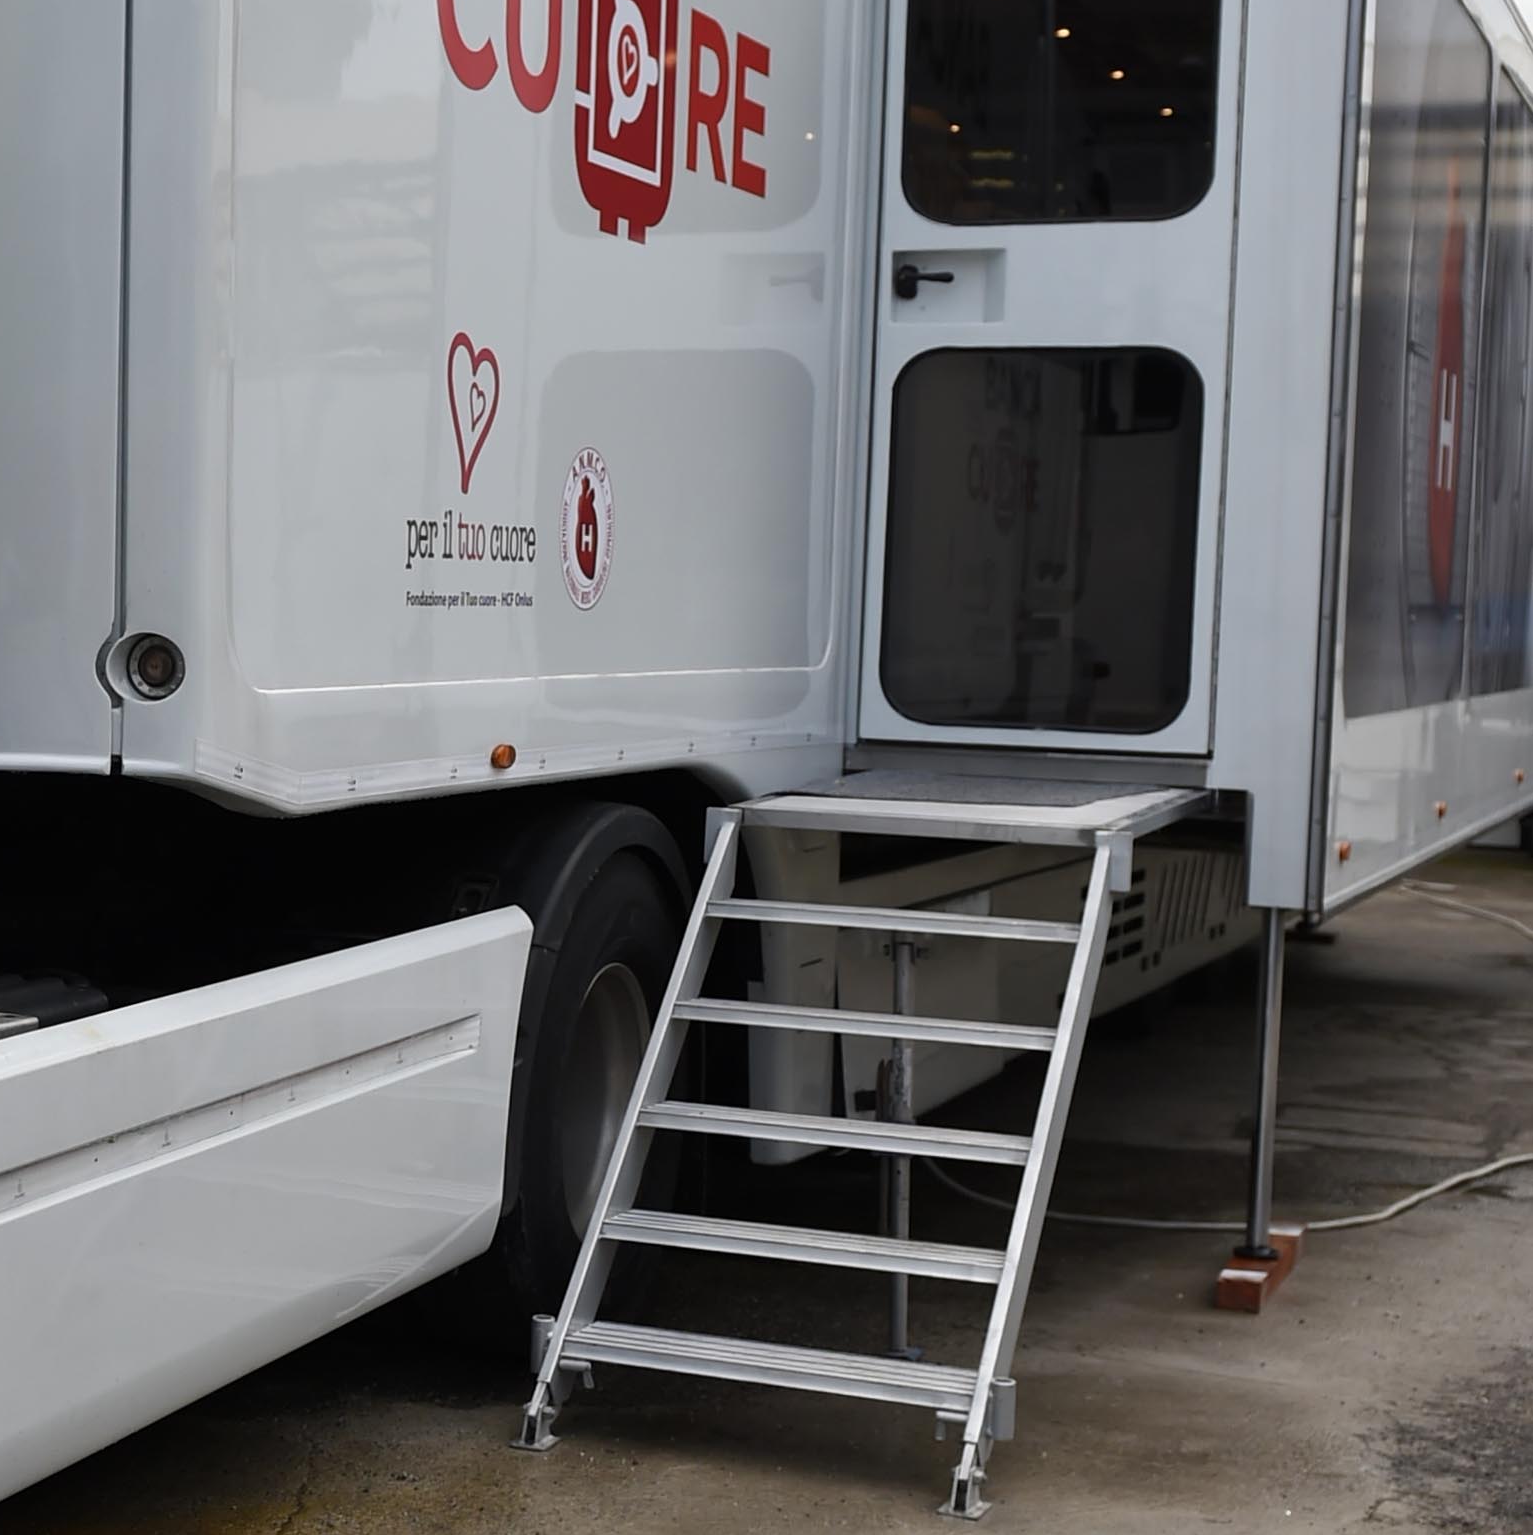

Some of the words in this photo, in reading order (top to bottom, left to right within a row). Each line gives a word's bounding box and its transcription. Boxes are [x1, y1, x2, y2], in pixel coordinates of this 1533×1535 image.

[405, 519, 438, 569] per
[442, 509, 454, 559] il
[457, 511, 486, 561] tuo
[489, 524, 536, 563] cuore
[406, 590, 447, 606] Fondazione
[447, 594, 460, 610] per
[465, 591, 478, 606] Tuo
[478, 594, 497, 606] cuore
[515, 592, 534, 606] Onlus
